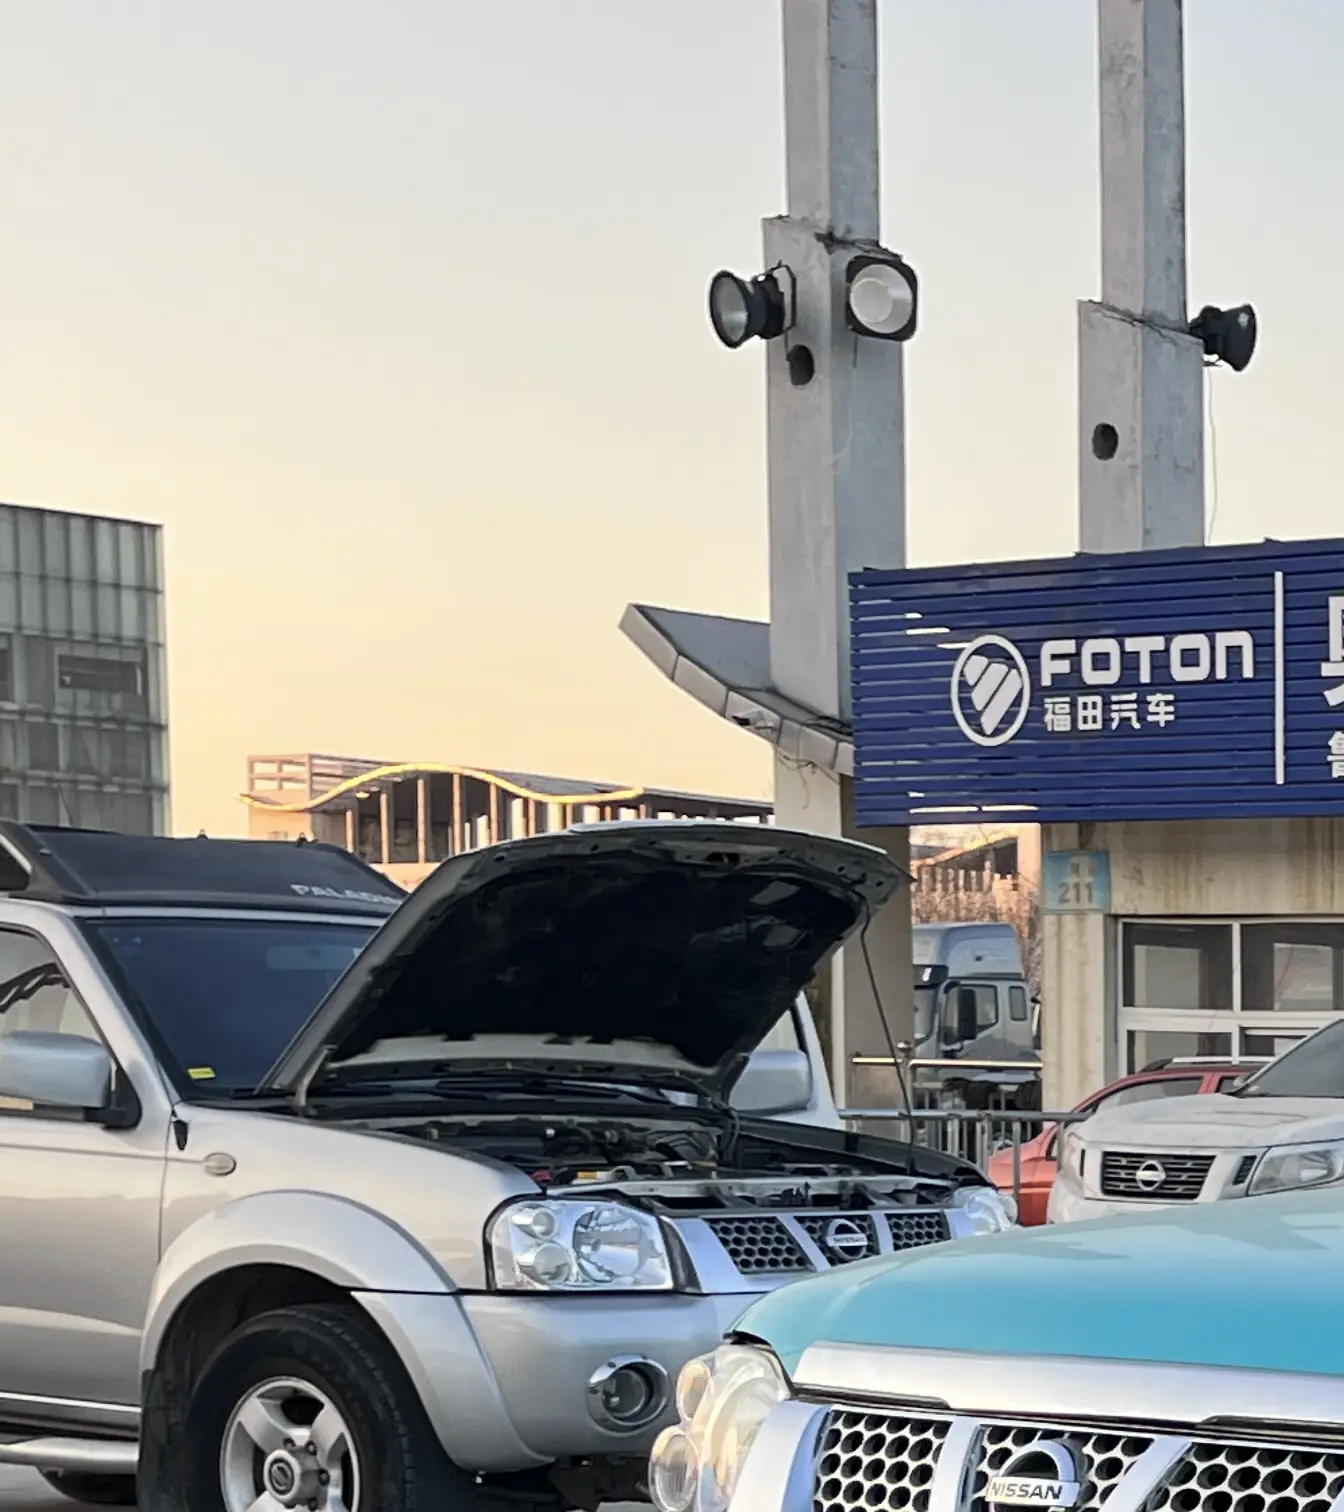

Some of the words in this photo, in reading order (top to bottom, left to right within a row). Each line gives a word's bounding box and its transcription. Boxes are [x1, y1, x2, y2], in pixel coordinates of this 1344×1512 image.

[1040, 631, 1255, 686] FOTON
[1043, 693, 1176, 731] 福田汽车
[990, 1482, 1063, 1500] NISSAN
